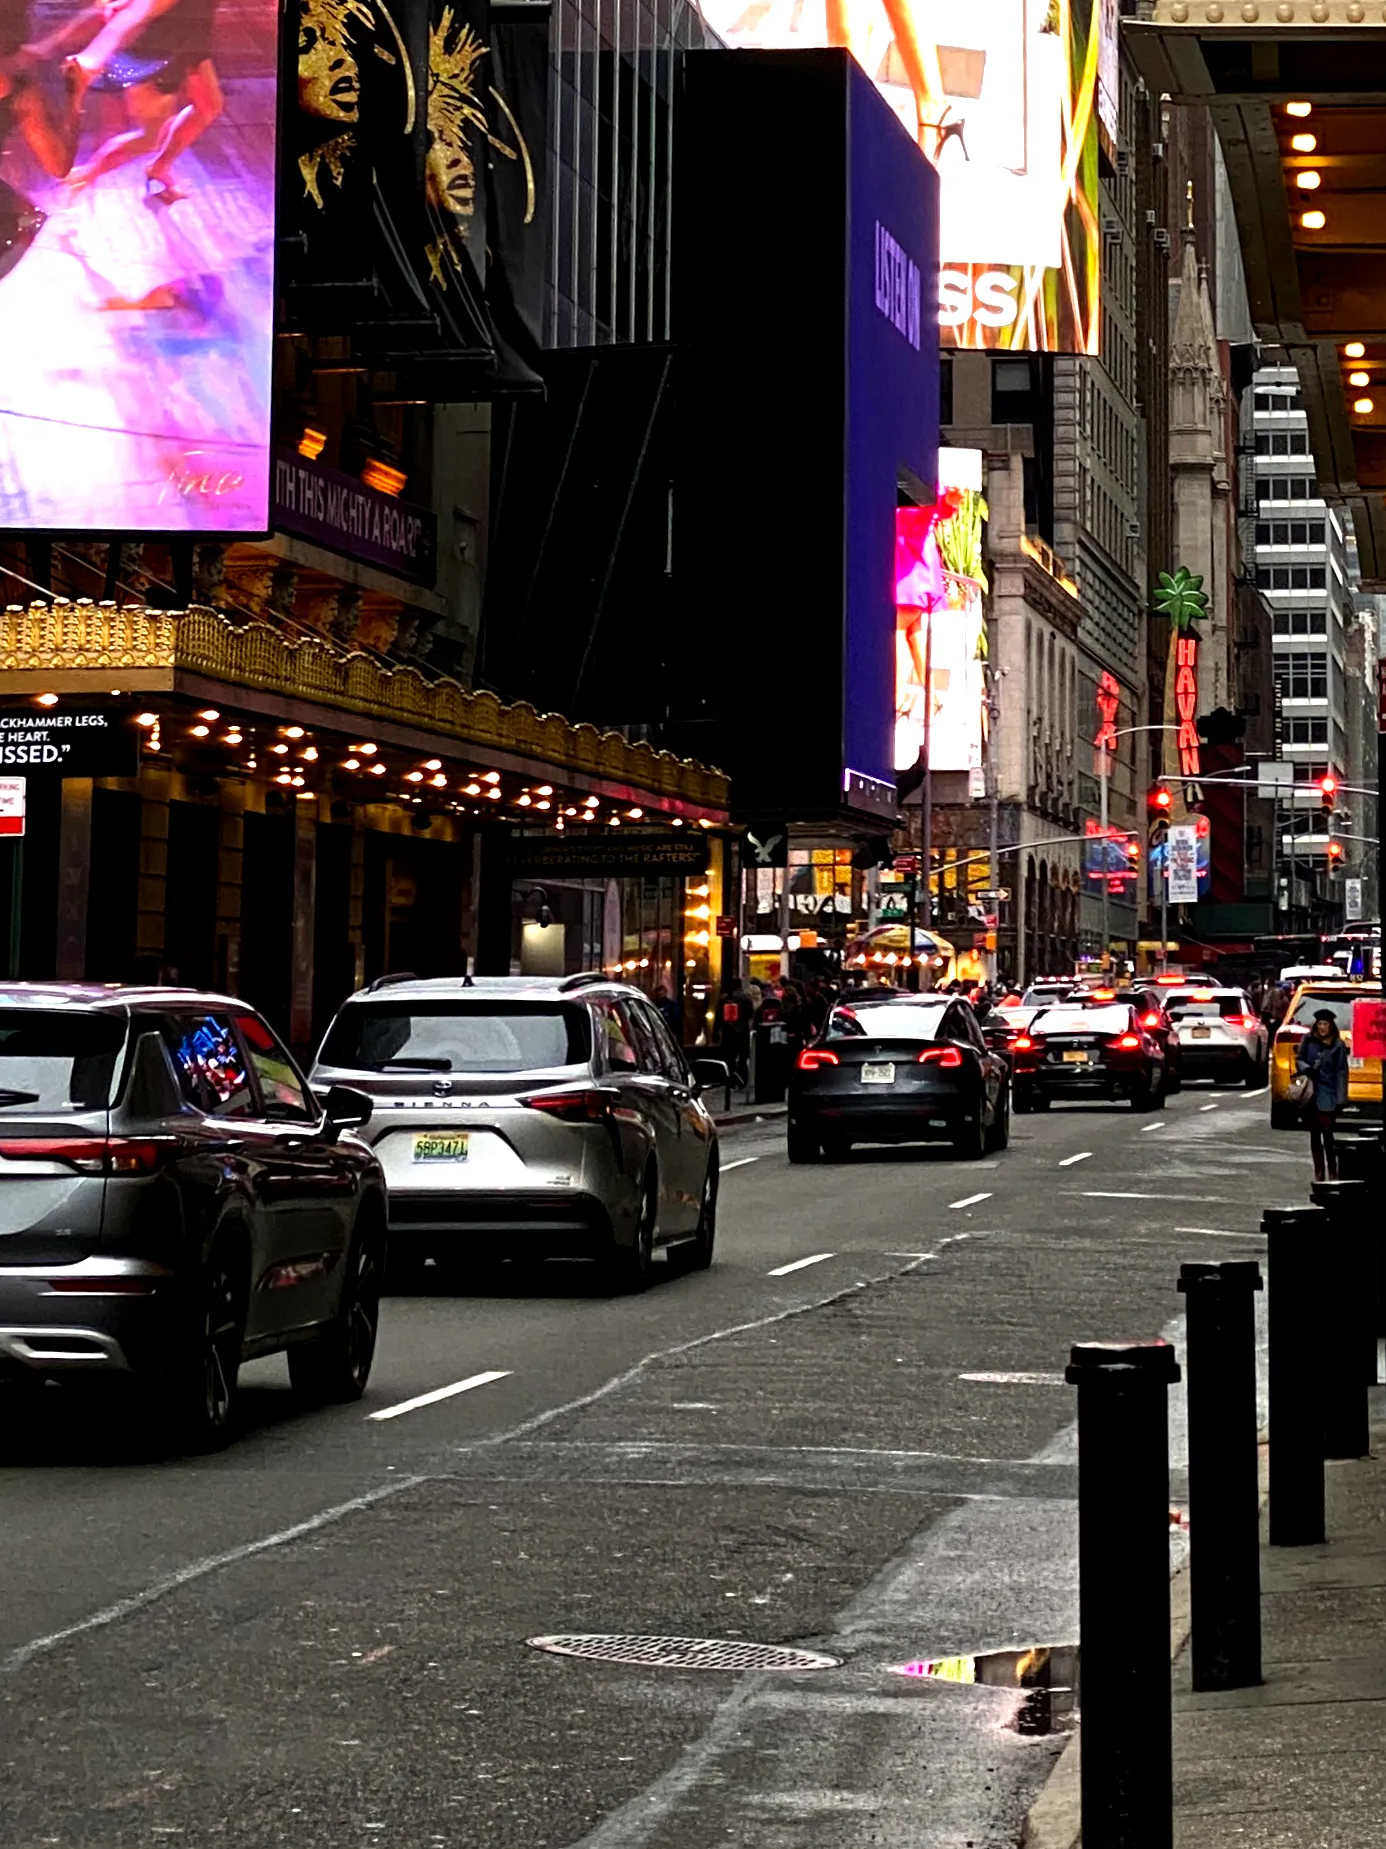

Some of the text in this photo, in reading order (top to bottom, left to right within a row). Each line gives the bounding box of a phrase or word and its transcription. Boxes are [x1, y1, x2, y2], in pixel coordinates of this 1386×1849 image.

[298, 469, 325, 522] THIS
[326, 481, 372, 540] MIGHTY
[372, 501, 381, 545] A
[0, 715, 108, 729] CKHAMMER LEGS,
[8, 731, 50, 743] HEART.
[601, 854, 616, 864] TO
[619, 853, 639, 864] THE
